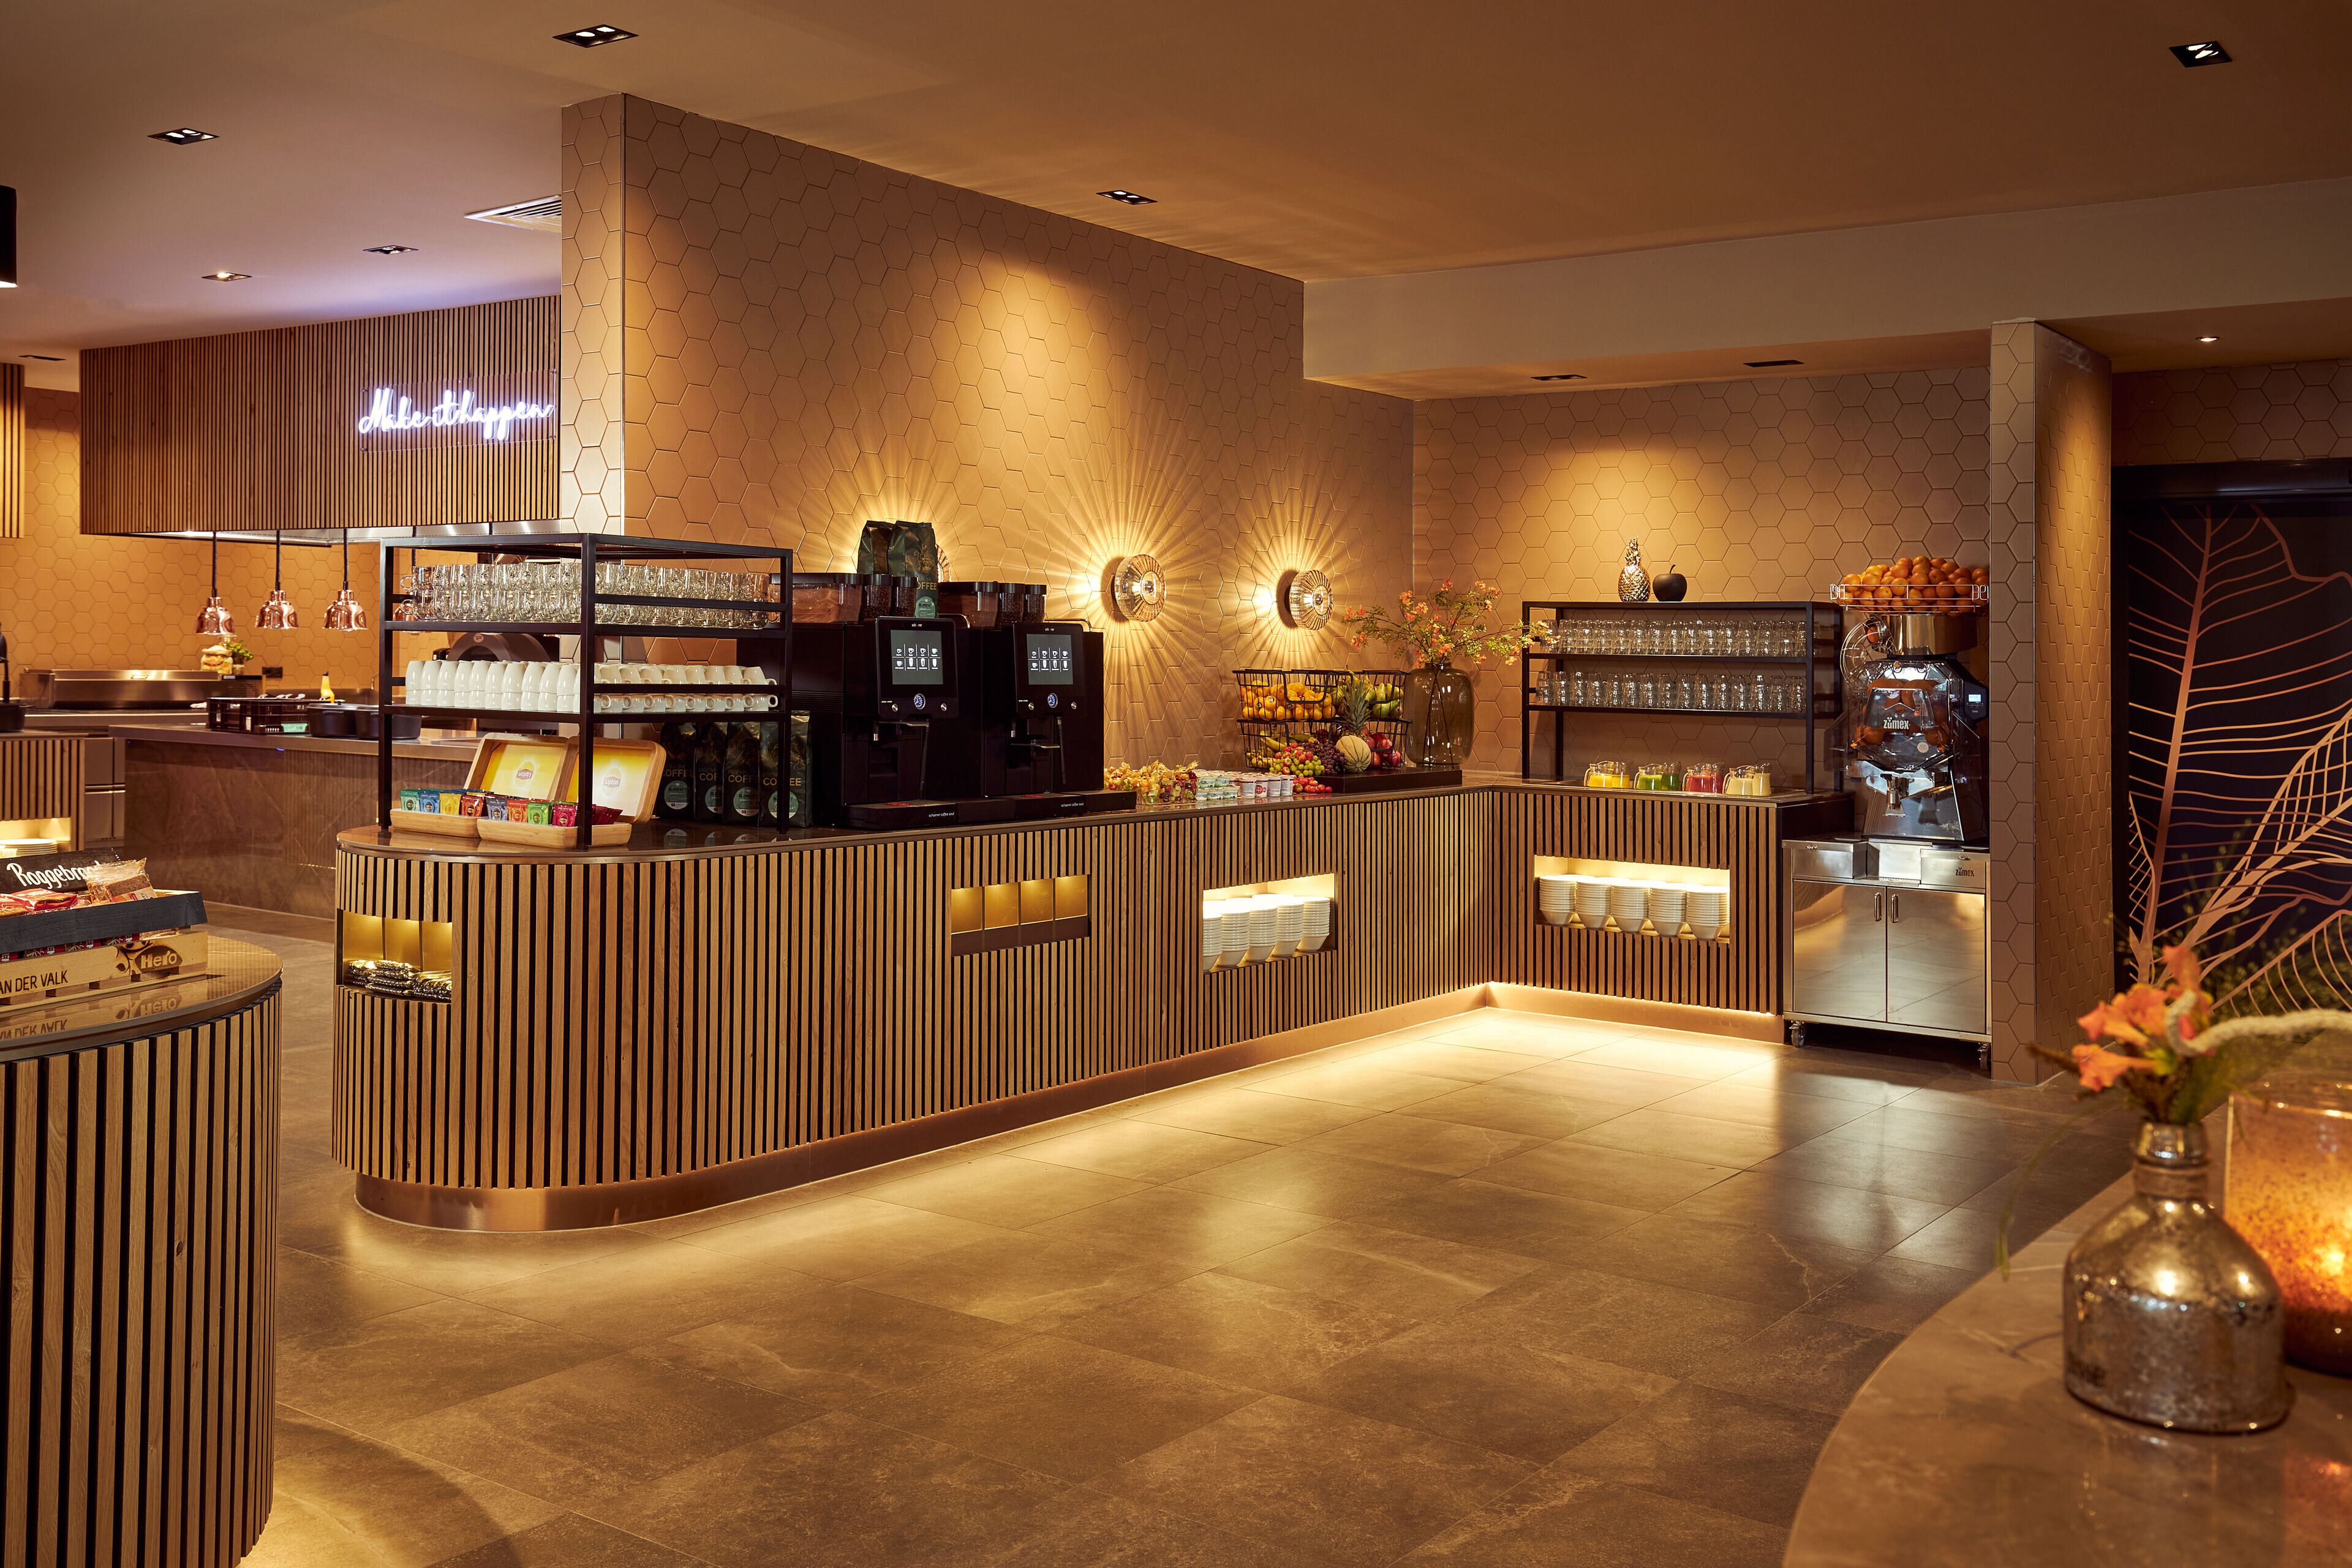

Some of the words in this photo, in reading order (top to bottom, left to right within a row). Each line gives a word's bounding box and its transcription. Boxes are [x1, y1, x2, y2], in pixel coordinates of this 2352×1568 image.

[358, 388, 429, 434] Make
[432, 390, 459, 427] it
[459, 390, 555, 440] happen
[917, 582, 937, 590] OFFEE
[699, 773, 718, 782] COF
[763, 777, 802, 786] COEE
[140, 950, 178, 970] Hero
[0, 979, 12, 994] AN
[15, 974, 37, 992] DER
[40, 970, 69, 988] VALK
